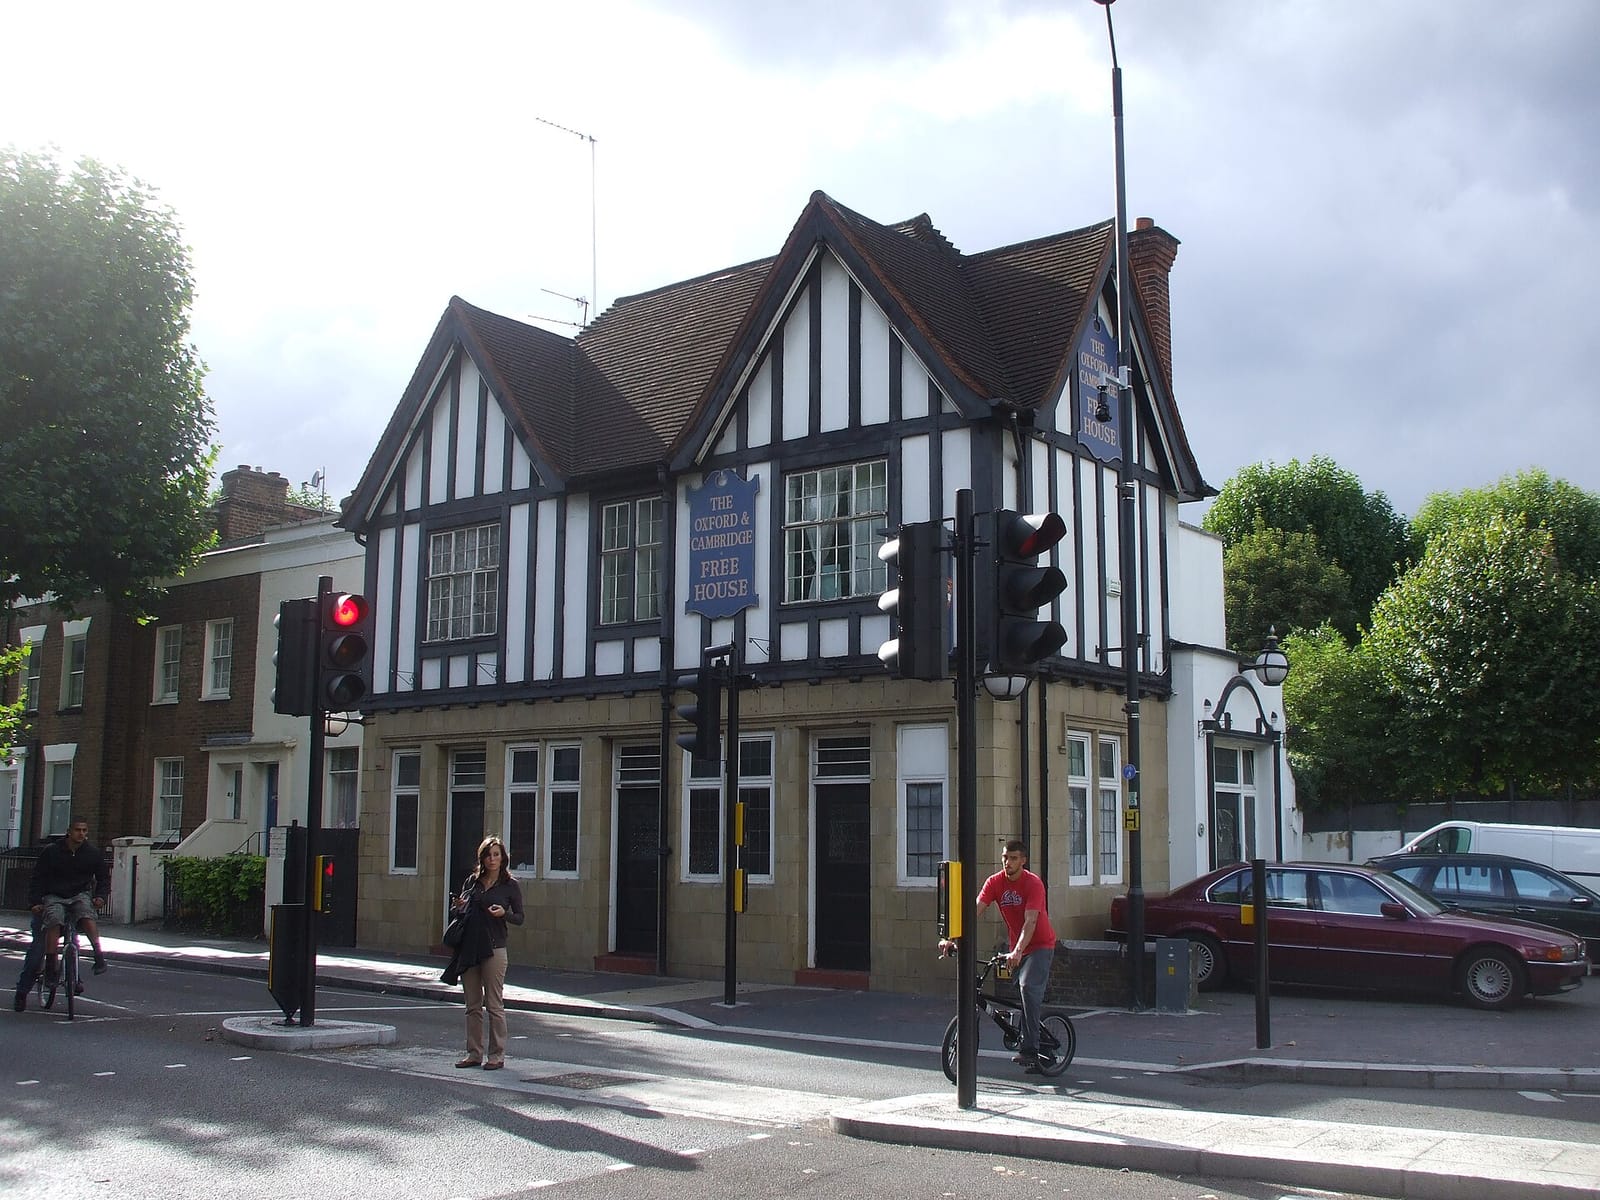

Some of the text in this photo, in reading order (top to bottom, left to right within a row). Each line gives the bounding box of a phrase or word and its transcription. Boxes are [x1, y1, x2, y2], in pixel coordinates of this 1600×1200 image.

[1090, 338, 1105, 357] THE
[1081, 352, 1109, 374] OXFORD
[1084, 416, 1116, 446] HOUSE
[710, 495, 733, 511] THE
[694, 511, 750, 532] OXFORD &
[691, 530, 753, 551] CAMBRIDGE
[700, 557, 740, 578] FREE
[694, 579, 748, 601] HOUSE
[1125, 812, 1136, 828] H
